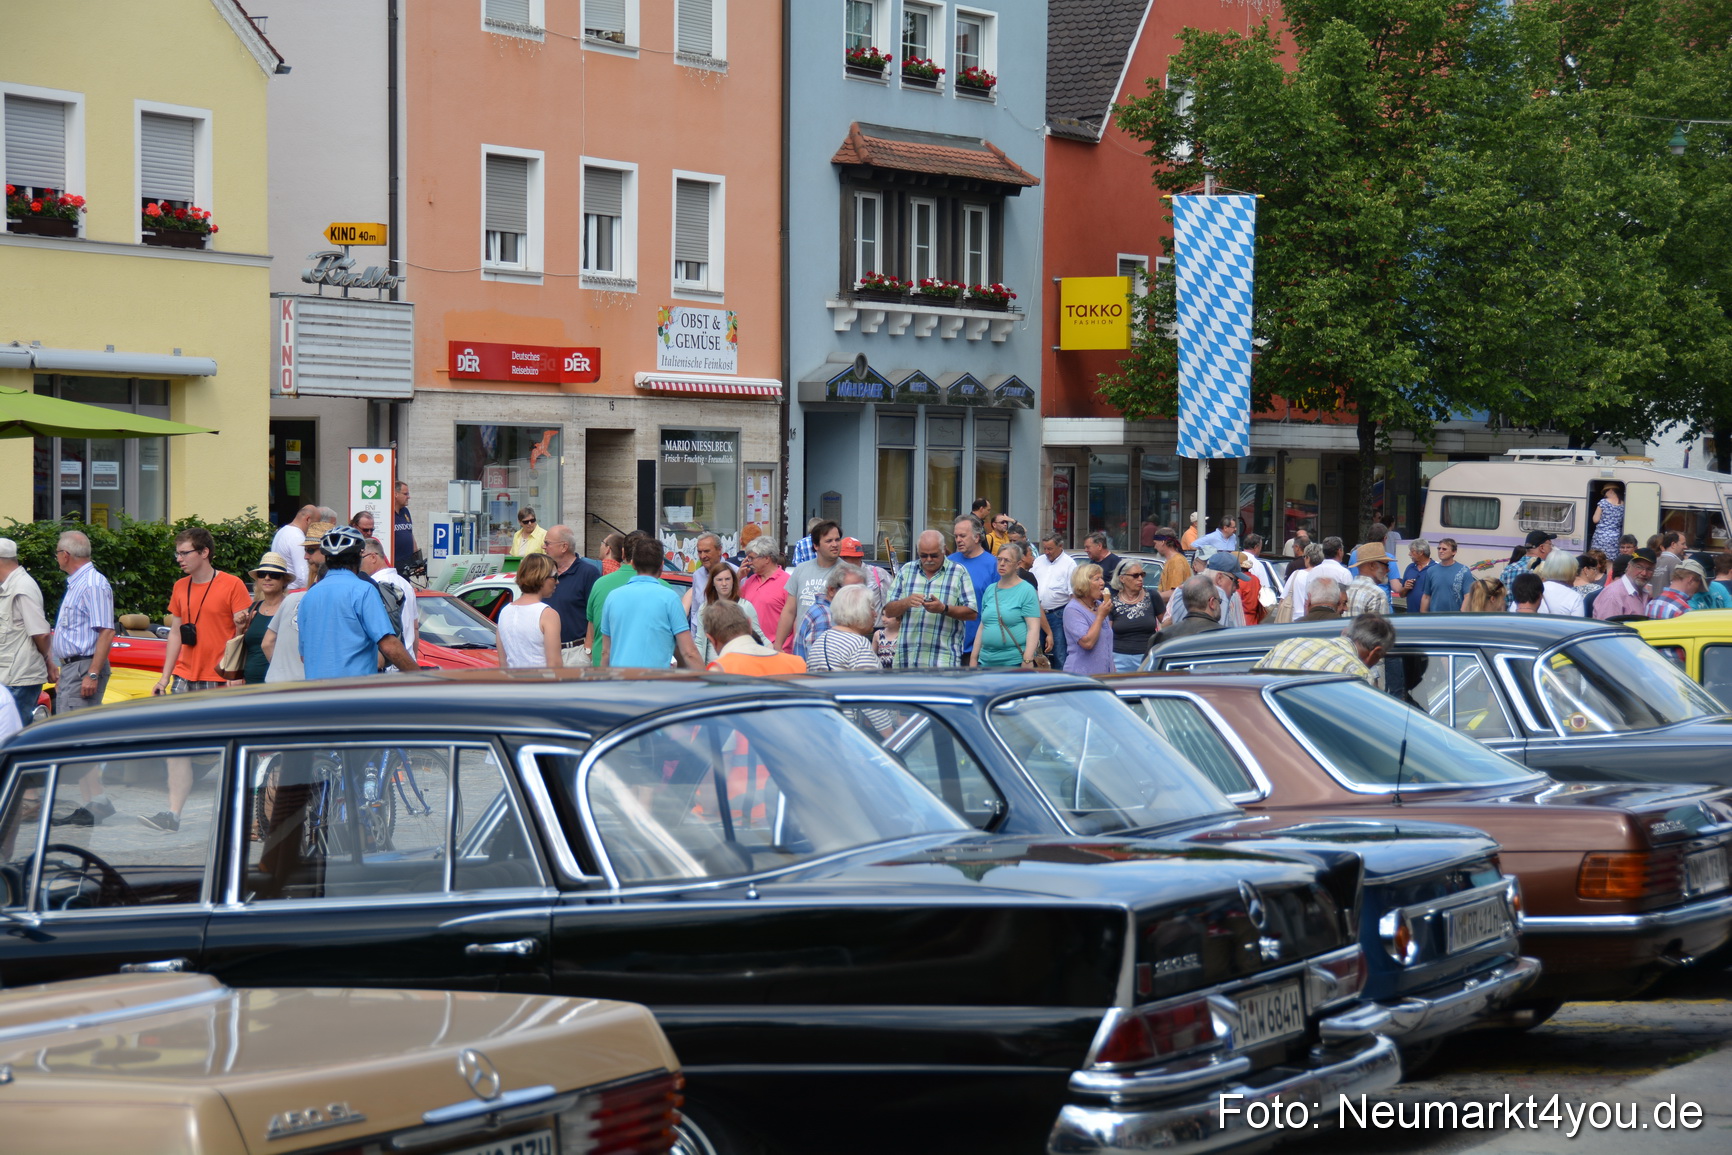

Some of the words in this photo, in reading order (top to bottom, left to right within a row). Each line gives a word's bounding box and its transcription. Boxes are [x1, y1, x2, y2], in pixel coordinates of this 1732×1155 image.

[330, 226, 356, 241] KINO
[301, 250, 406, 289] Rialto
[681, 312, 709, 329] OBST
[712, 315, 720, 330] &
[282, 299, 293, 389] KINO
[675, 331, 720, 350] GEMÜSE
[457, 355, 480, 372] DER
[512, 351, 540, 361] Deutsches
[661, 354, 702, 368] Italienische
[704, 357, 733, 370] Feinkost
[512, 366, 538, 375] Reisebüro
[564, 357, 591, 372] DER
[609, 401, 615, 411] 15
[665, 440, 690, 451] MARIO
[692, 440, 733, 452] NIESSLBECK
[665, 453, 681, 463] Frisch
[436, 528, 446, 545] P
[1268, 991, 1301, 1033] 684H
